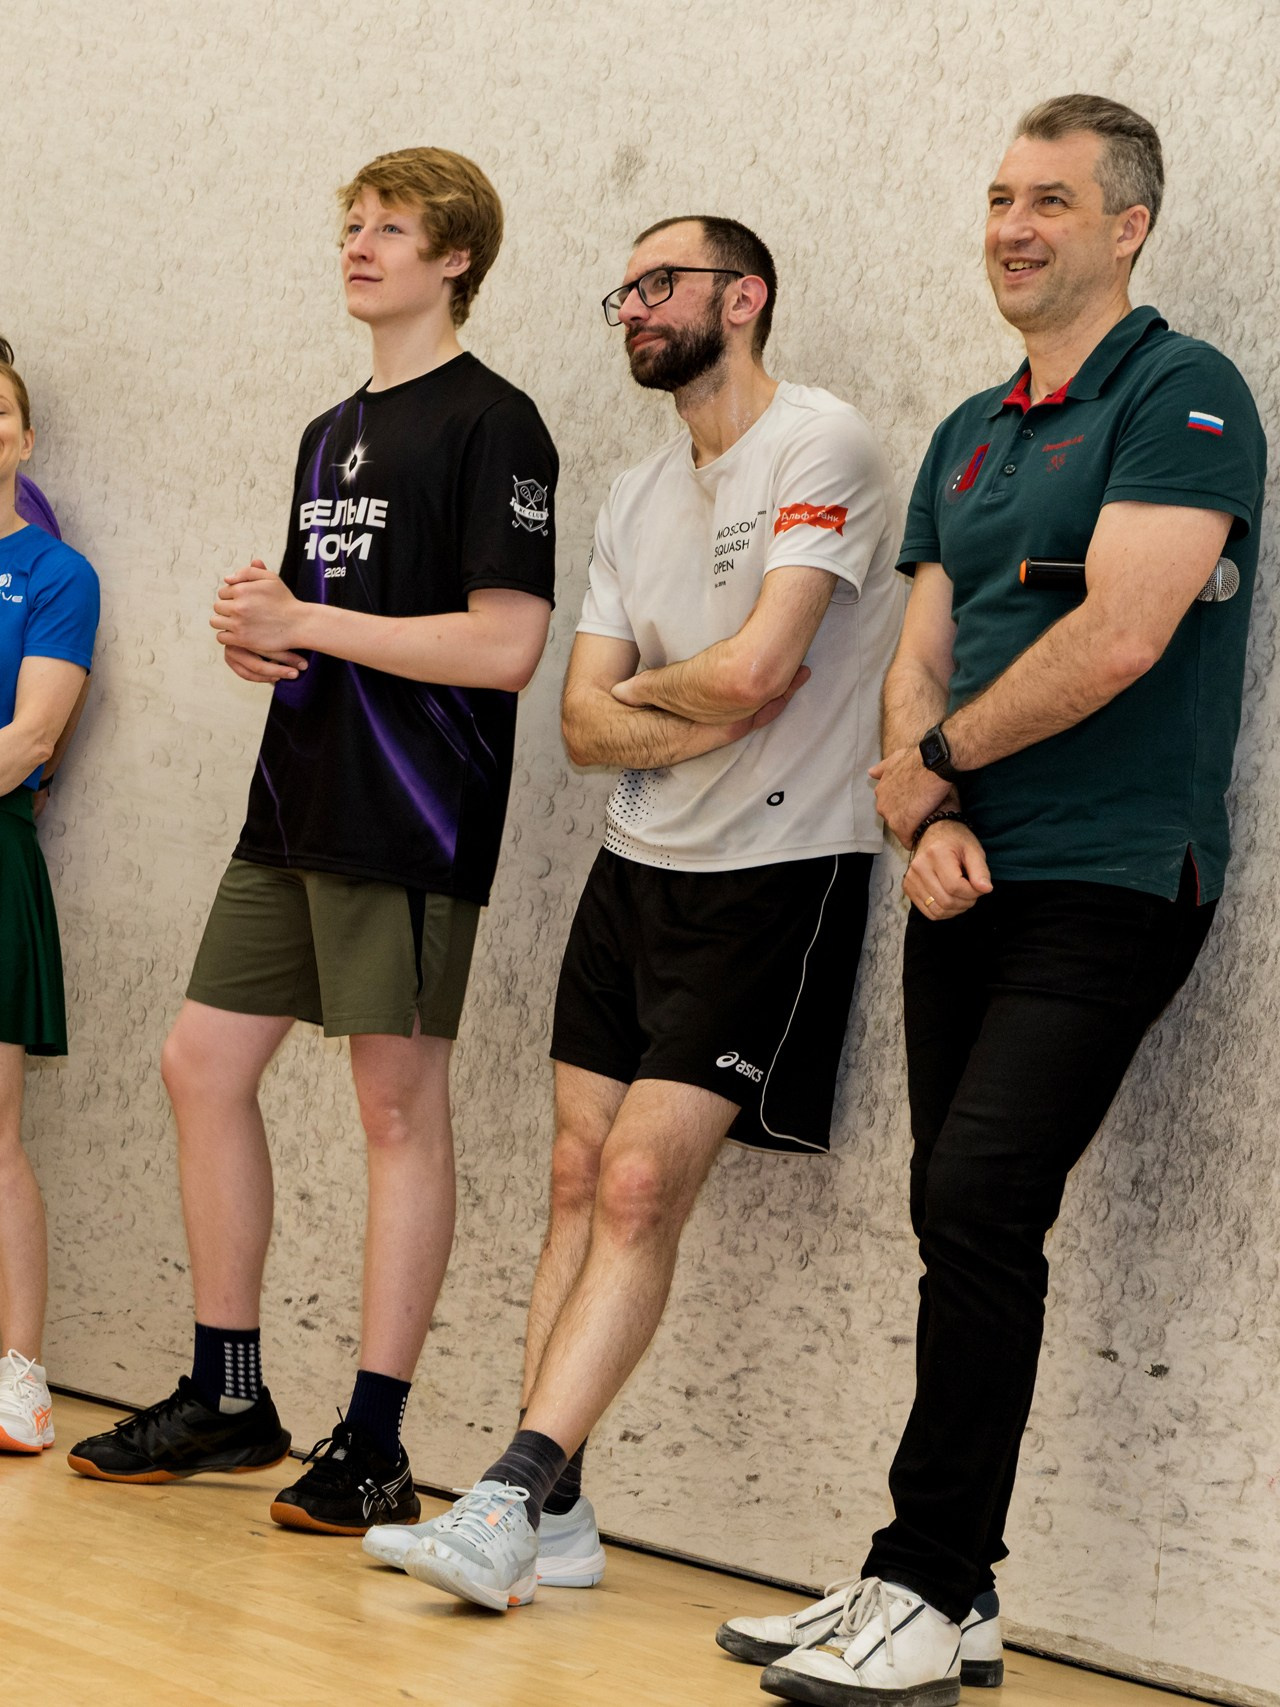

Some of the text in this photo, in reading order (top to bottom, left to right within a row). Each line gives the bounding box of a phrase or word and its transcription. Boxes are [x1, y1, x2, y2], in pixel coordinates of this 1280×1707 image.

[299, 496, 389, 531] БЕЛЫЕ
[716, 517, 758, 541] MOSCOW
[714, 538, 750, 558] SQUASH
[713, 558, 735, 575] OPEN
[735, 1059, 765, 1083] asics
